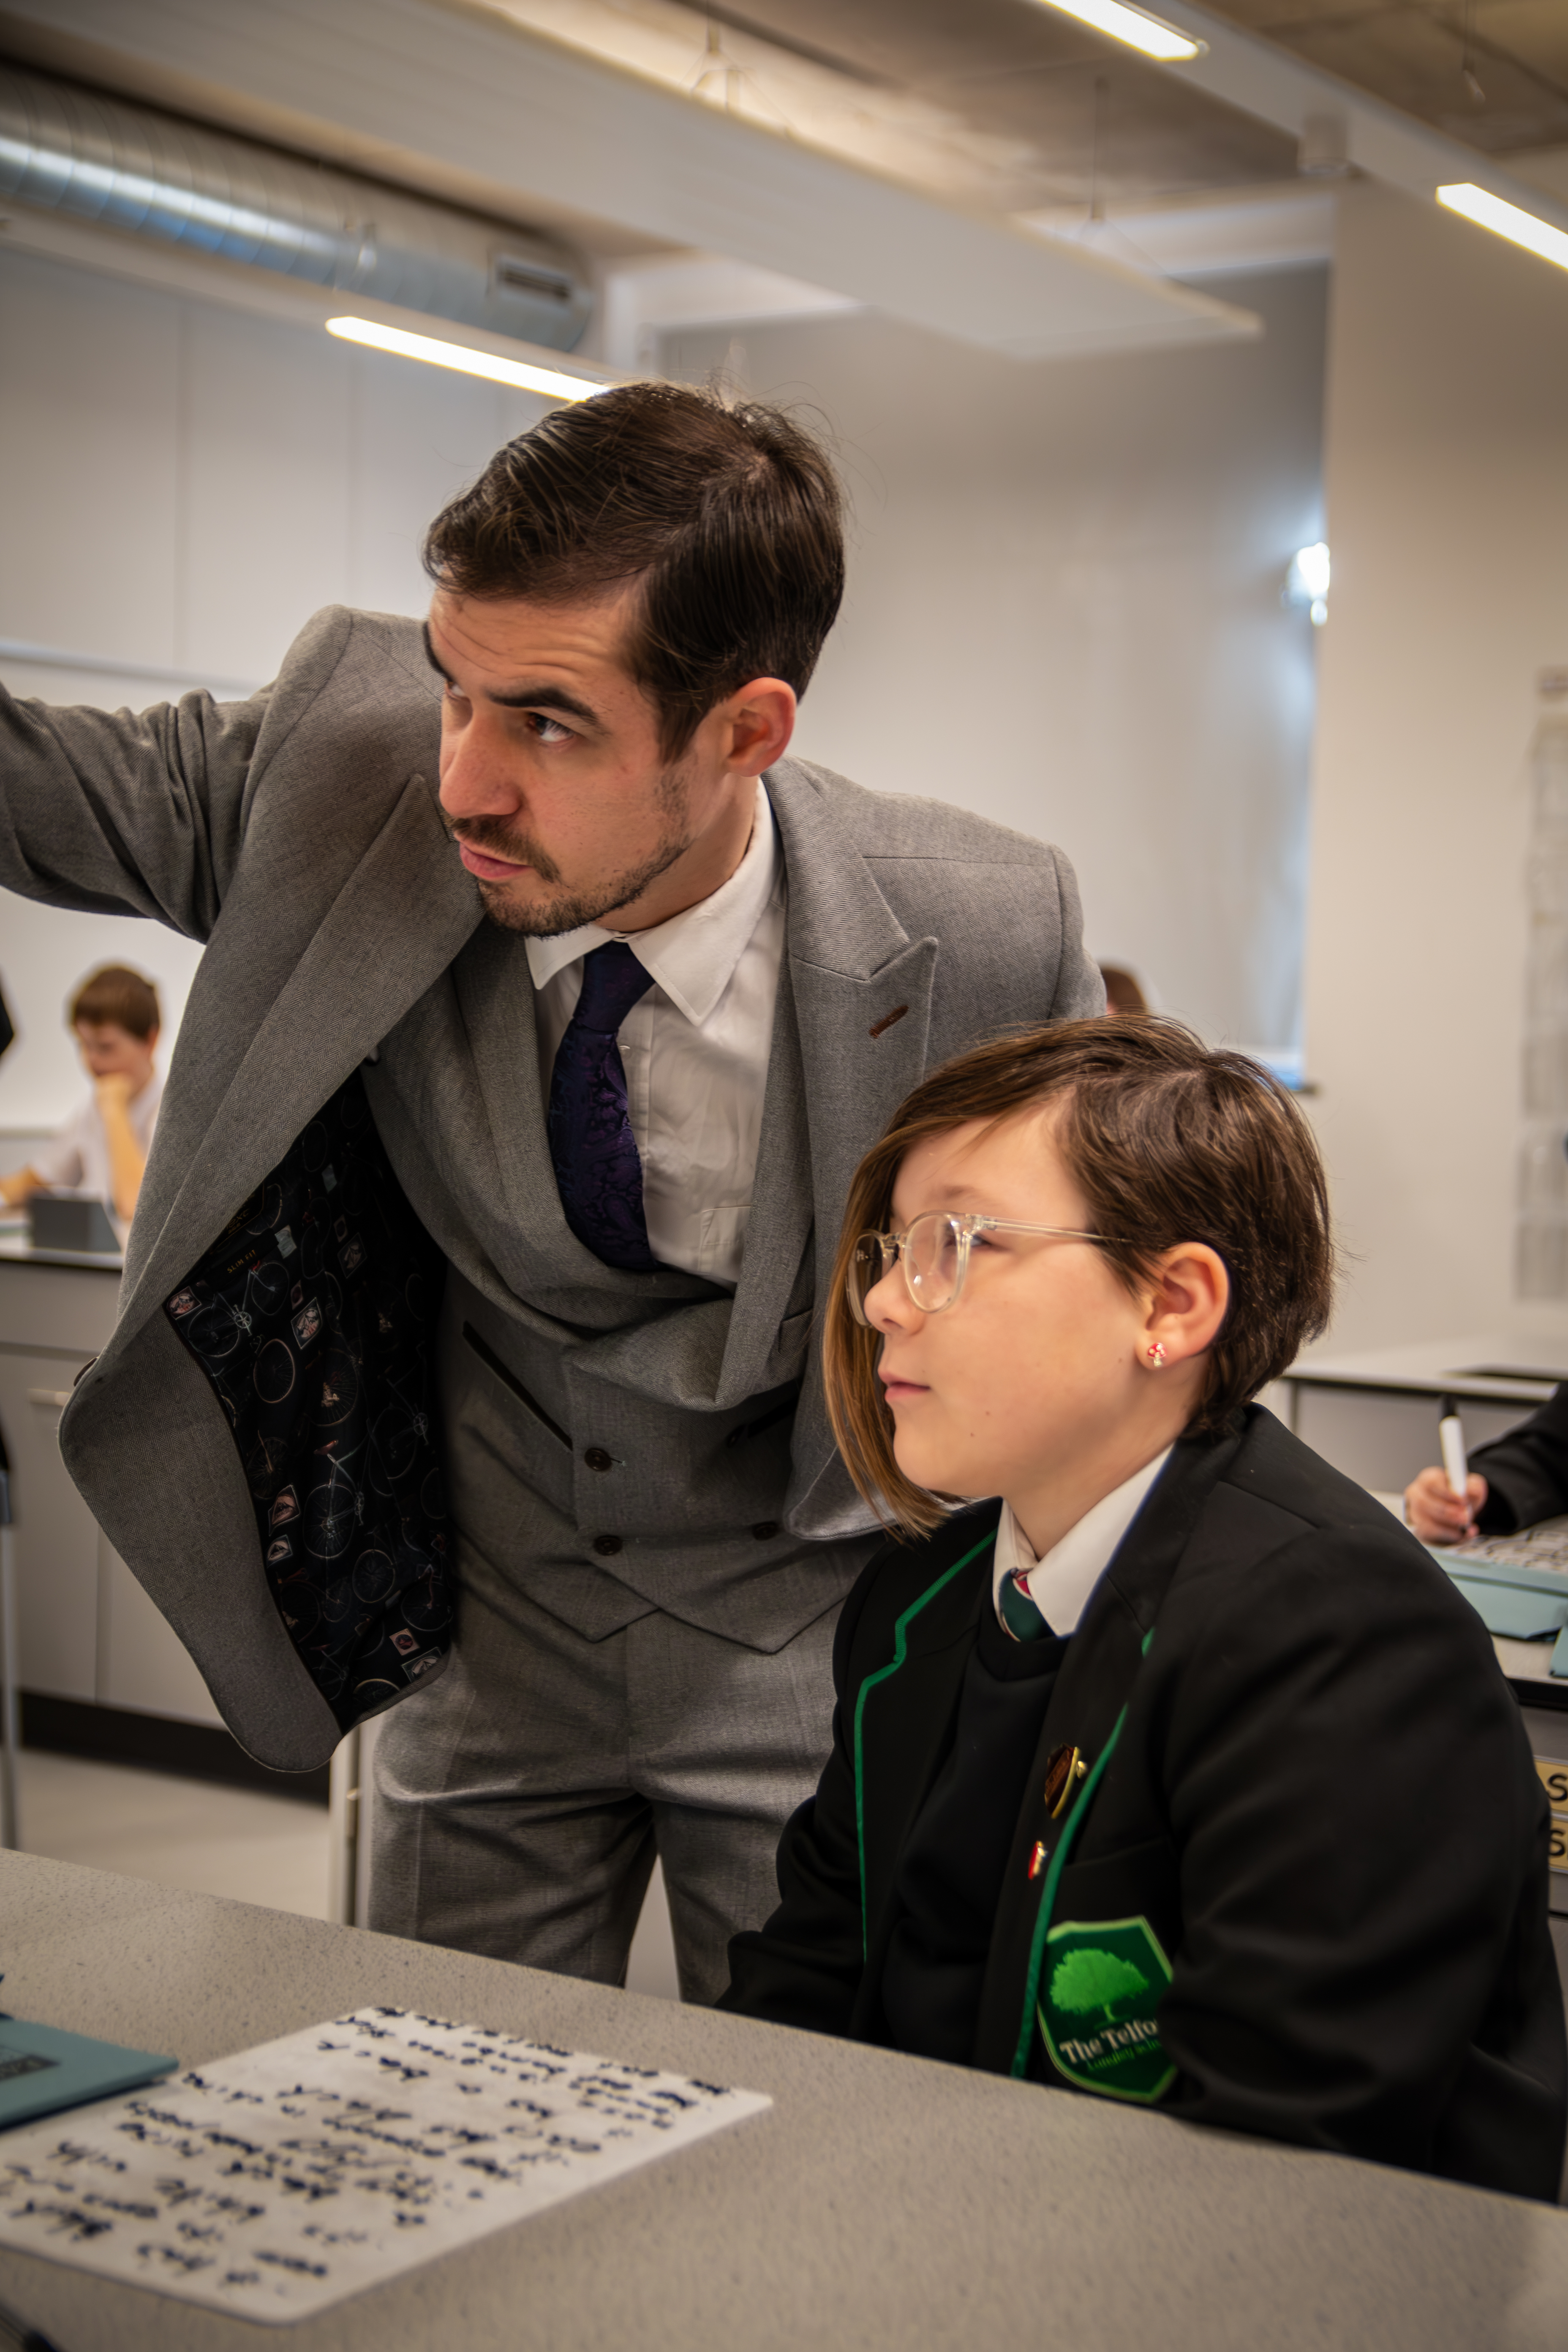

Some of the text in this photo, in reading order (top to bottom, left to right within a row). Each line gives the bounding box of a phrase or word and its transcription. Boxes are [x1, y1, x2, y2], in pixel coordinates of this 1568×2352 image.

[227, 1249, 257, 1274] SLIM FIT
[1059, 2036, 1105, 2065] The
[1100, 2017, 1159, 2050] Telfo
